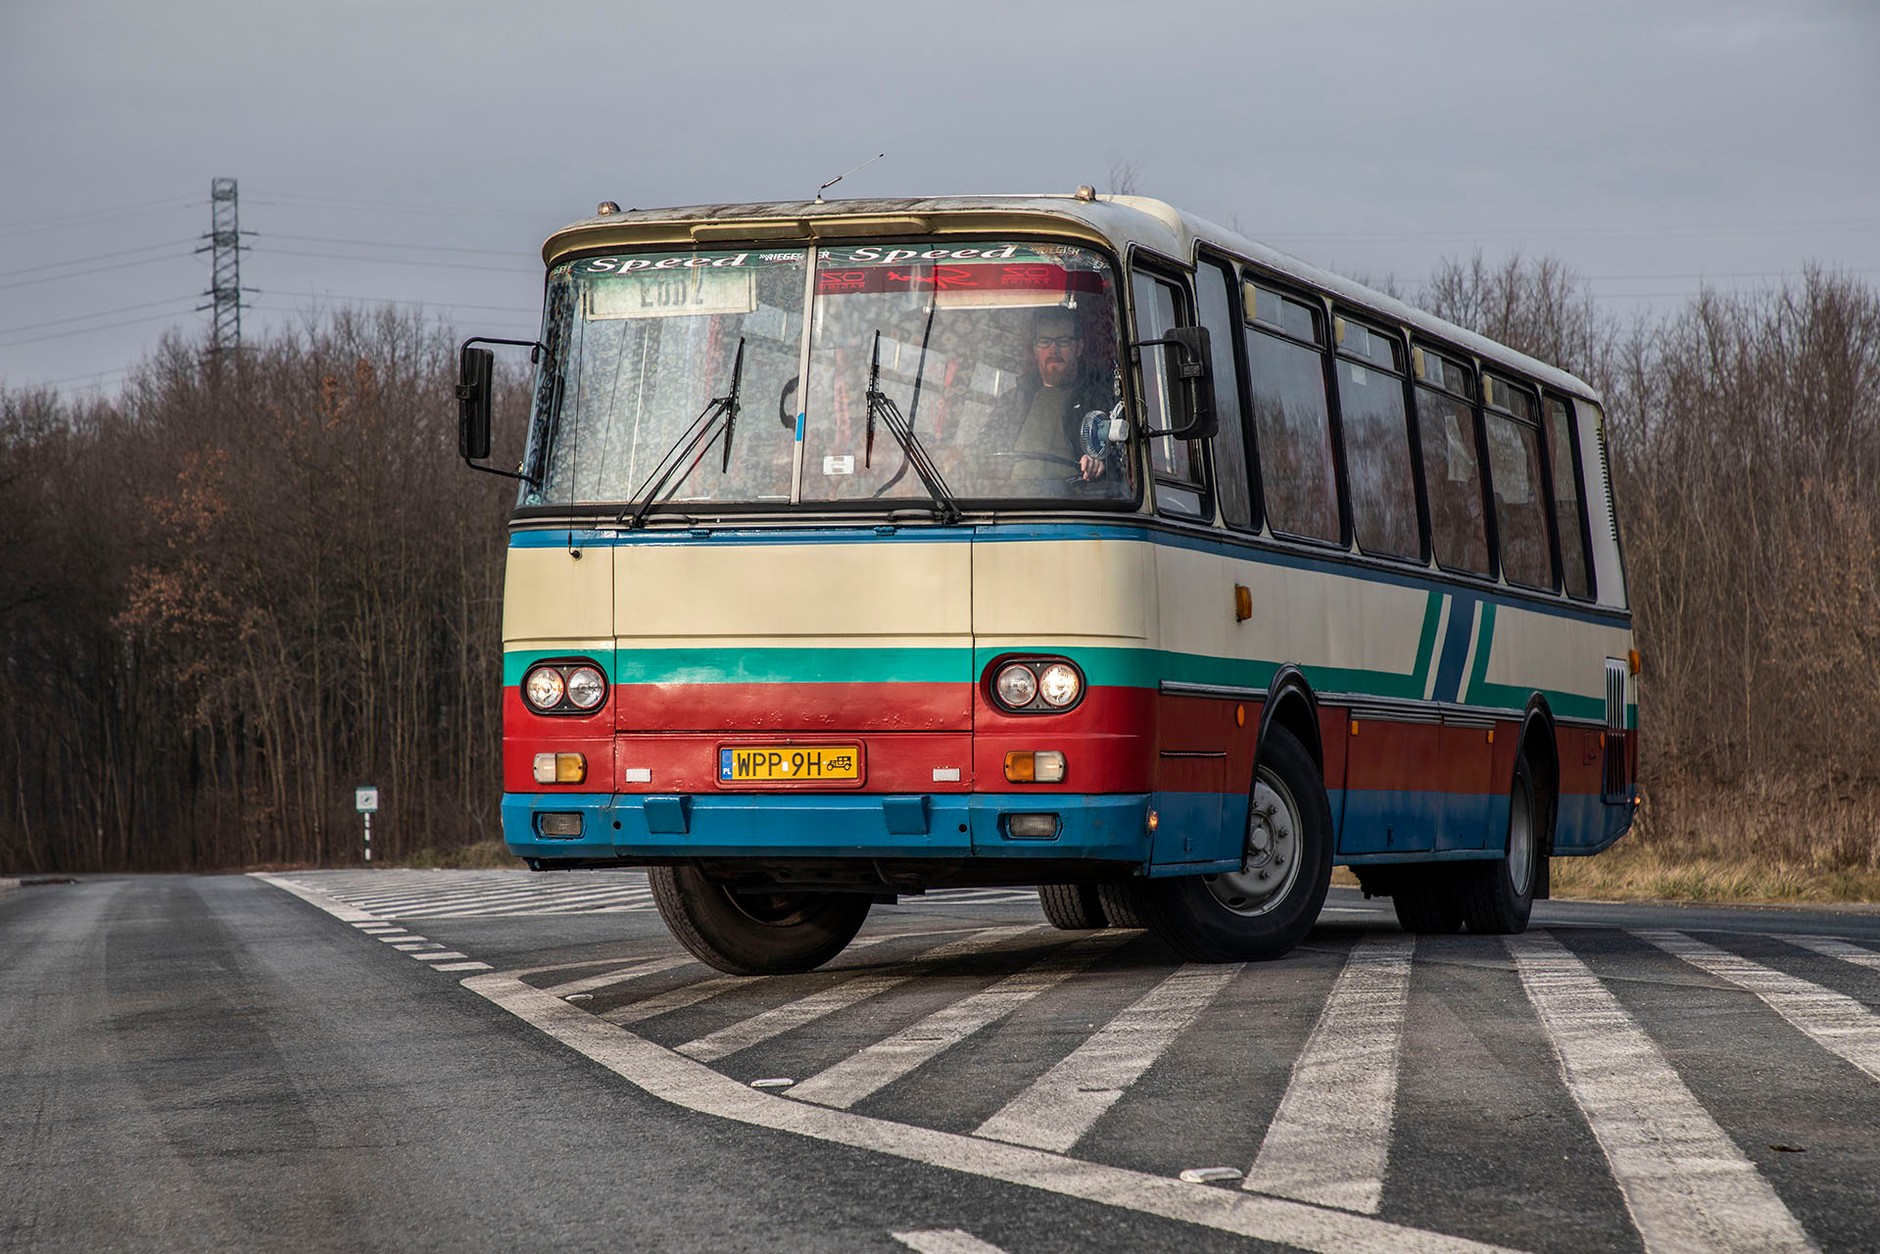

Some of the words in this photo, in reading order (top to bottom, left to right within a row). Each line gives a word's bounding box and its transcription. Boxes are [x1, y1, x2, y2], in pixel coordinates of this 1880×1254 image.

[587, 252, 749, 274] Speed
[849, 244, 1019, 264] Speed
[722, 767, 732, 775] PL
[737, 752, 782, 777] WPP
[791, 752, 821, 776] 9H
